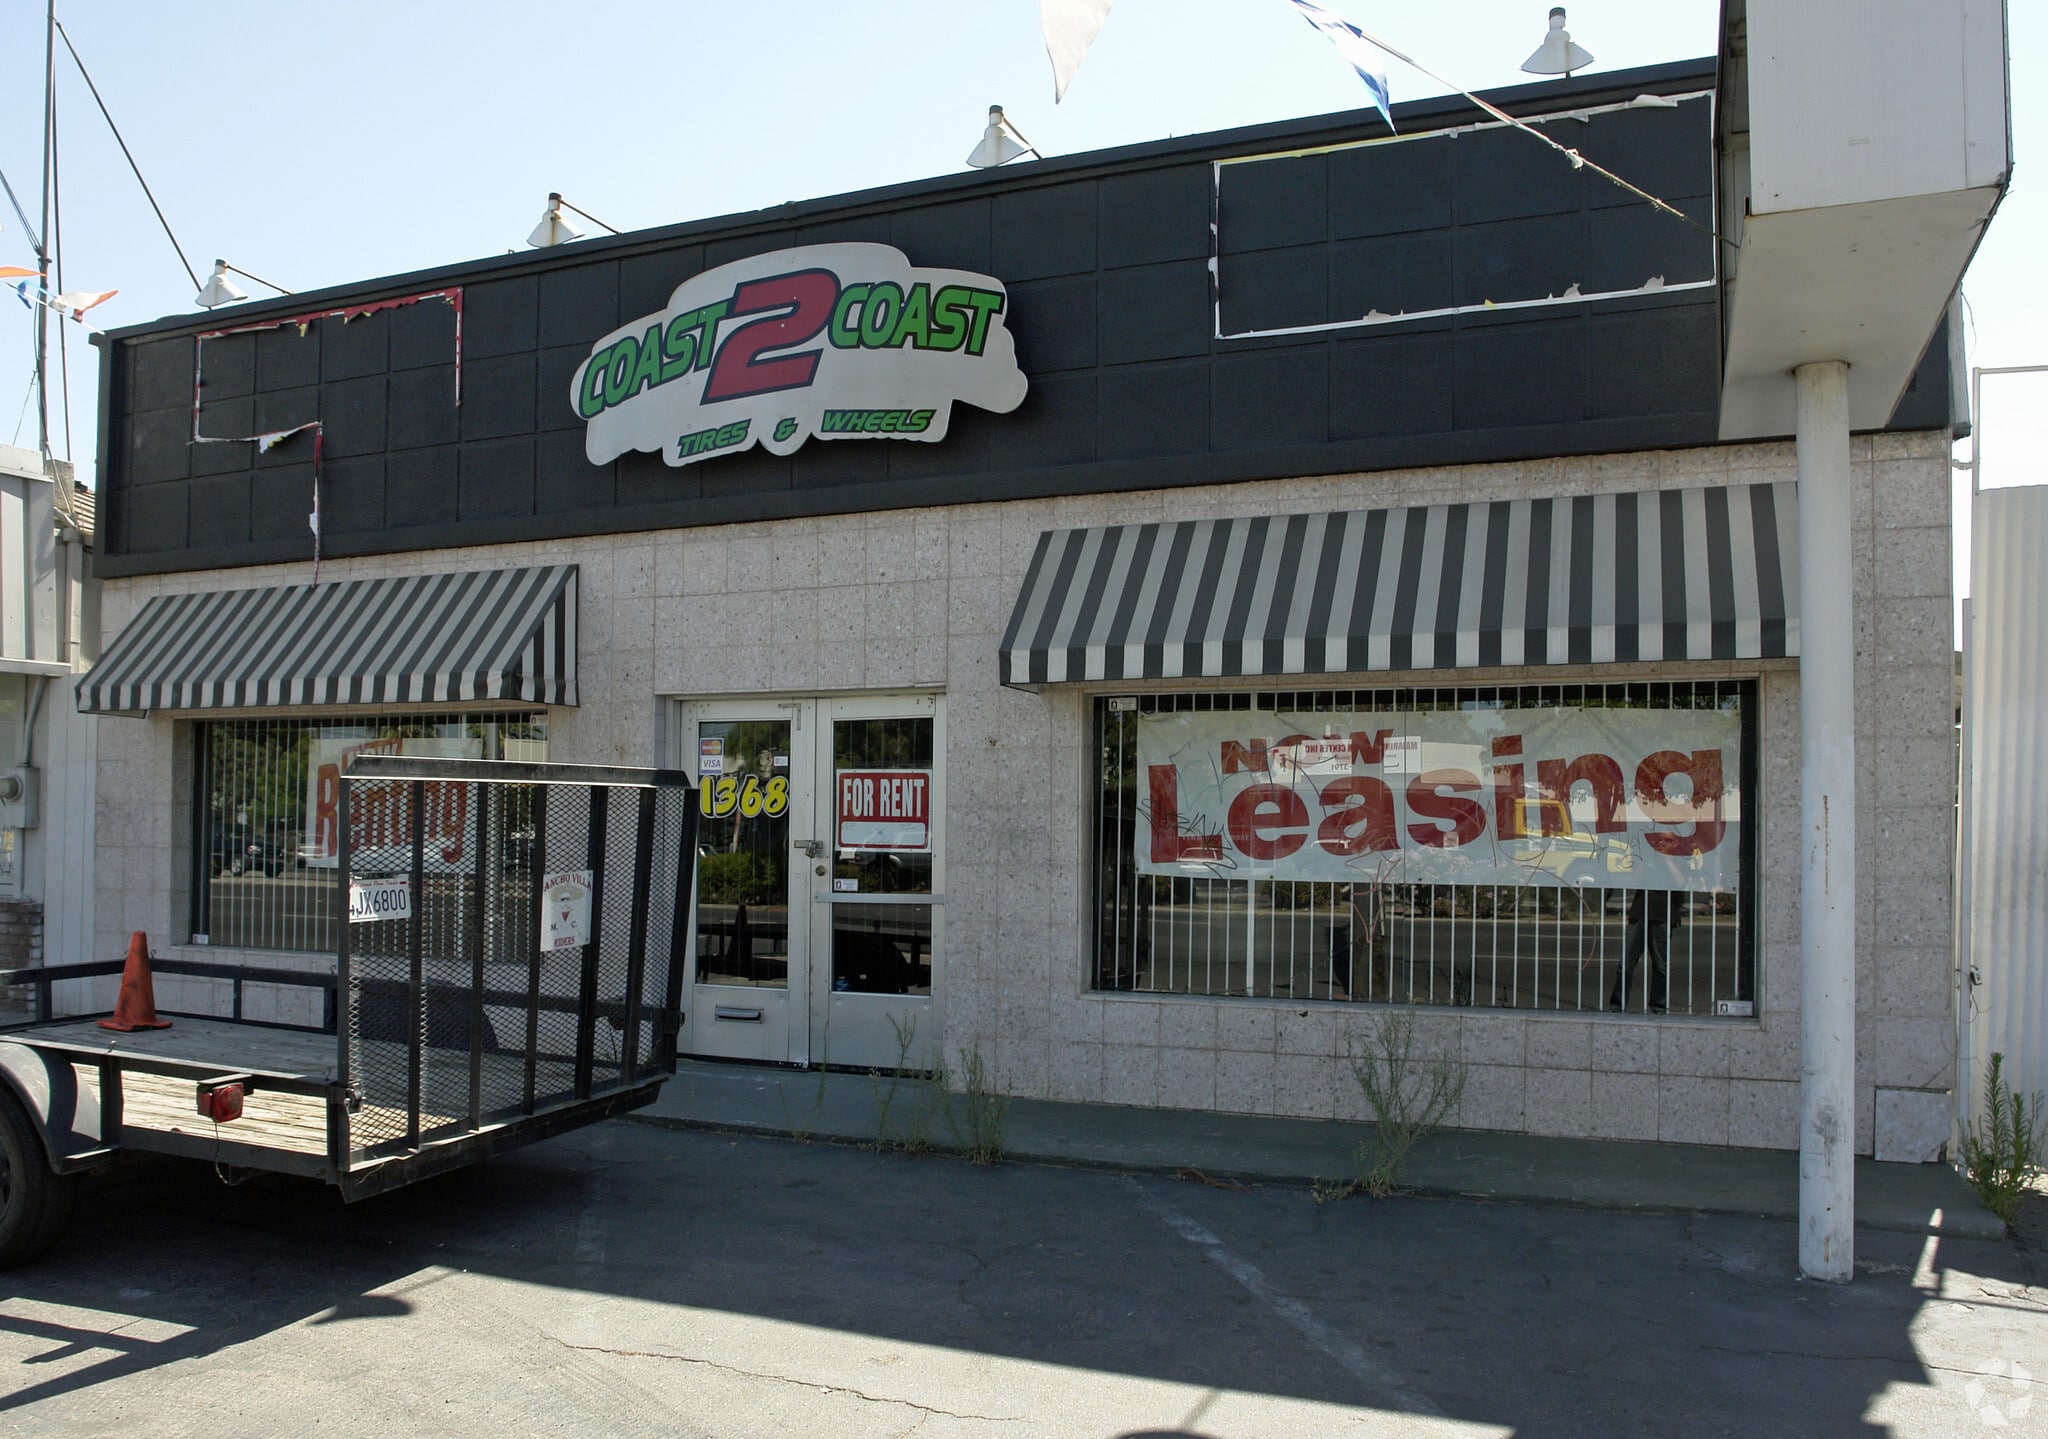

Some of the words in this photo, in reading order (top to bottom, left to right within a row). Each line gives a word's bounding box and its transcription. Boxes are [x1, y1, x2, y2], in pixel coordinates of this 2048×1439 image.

[577, 298, 735, 420] COAST
[700, 267, 842, 406] 2
[829, 281, 1006, 357] COAST
[677, 418, 752, 459] TIRES
[773, 416, 798, 442] &
[820, 409, 937, 434] WHEELS
[703, 759, 721, 769] VISA
[1221, 729, 1394, 775] NOW
[700, 775, 790, 818] 1368
[843, 778, 874, 816] FOR
[880, 778, 925, 817] RENT
[1147, 734, 1727, 864] Leasing
[544, 874, 570, 892] ANCHO
[572, 873, 592, 891] VILLA
